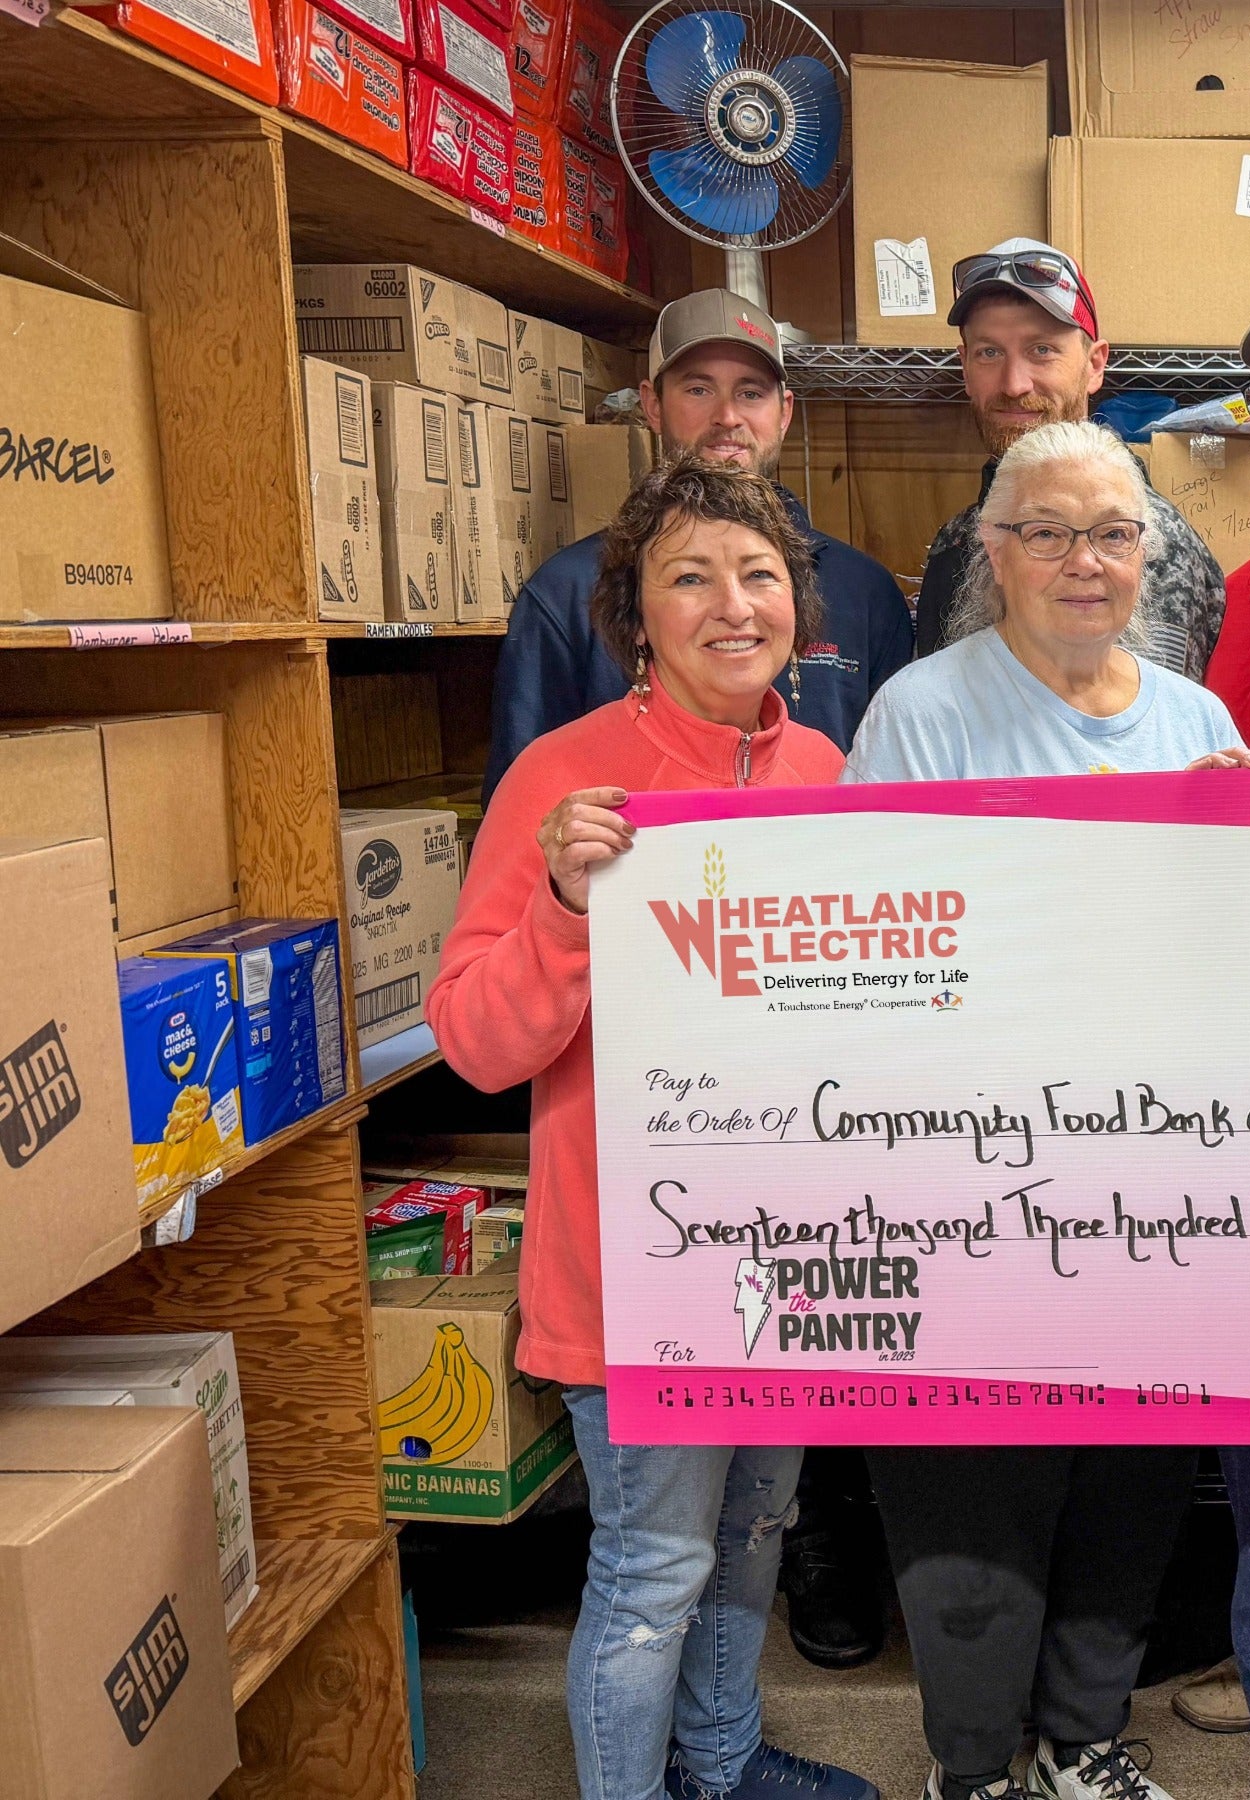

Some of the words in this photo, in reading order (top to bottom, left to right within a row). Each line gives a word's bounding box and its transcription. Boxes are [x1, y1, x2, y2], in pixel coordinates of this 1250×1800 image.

[363, 79, 390, 107] Ramen
[362, 97, 399, 131] Maruchan
[364, 281, 407, 297] 06002
[425, 322, 450, 340] OREO
[65, 564, 133, 585] B940874
[366, 624, 396, 637] RAMEN
[397, 623, 433, 637] NOODLES
[424, 834, 449, 852] 14740
[355, 849, 400, 909] Gardetto's
[351, 908, 384, 931] Original
[386, 902, 411, 921] Recipe
[647, 891, 966, 980] WHEATLAND
[720, 927, 958, 997] ELECTRIC
[215, 971, 227, 998] 5
[764, 973, 847, 990] Delivering
[853, 972, 907, 989] Energy
[914, 970, 935, 984] for
[941, 970, 969, 984] Life
[215, 997, 229, 1012] pack
[768, 1003, 775, 1012] A
[778, 1001, 831, 1012] Touchstone
[871, 998, 926, 1010] Cooperative
[645, 1069, 695, 1101] Pay
[698, 1073, 720, 1090] to
[18, 1070, 77, 1159] jim
[647, 1110, 680, 1133] the
[687, 1108, 755, 1134] Order
[760, 1106, 798, 1140] Of
[812, 1079, 1033, 1168] Community
[1042, 1081, 1128, 1133] Food
[1136, 1083, 1235, 1148] Bank
[646, 1180, 855, 1267] Seventeen
[844, 1194, 1000, 1266] thousand
[1002, 1178, 1108, 1278] Three
[1112, 1191, 1247, 1267] hundred
[777, 1256, 919, 1300] POWER
[788, 1290, 817, 1312] the
[778, 1312, 922, 1352] PANTRY
[654, 1341, 696, 1362] For
[879, 1351, 889, 1361] in
[463, 1459, 493, 1468] 1100-01
[416, 1473, 501, 1496] BANANAS
[111, 1612, 180, 1712] slim
[137, 1642, 186, 1732] jim
